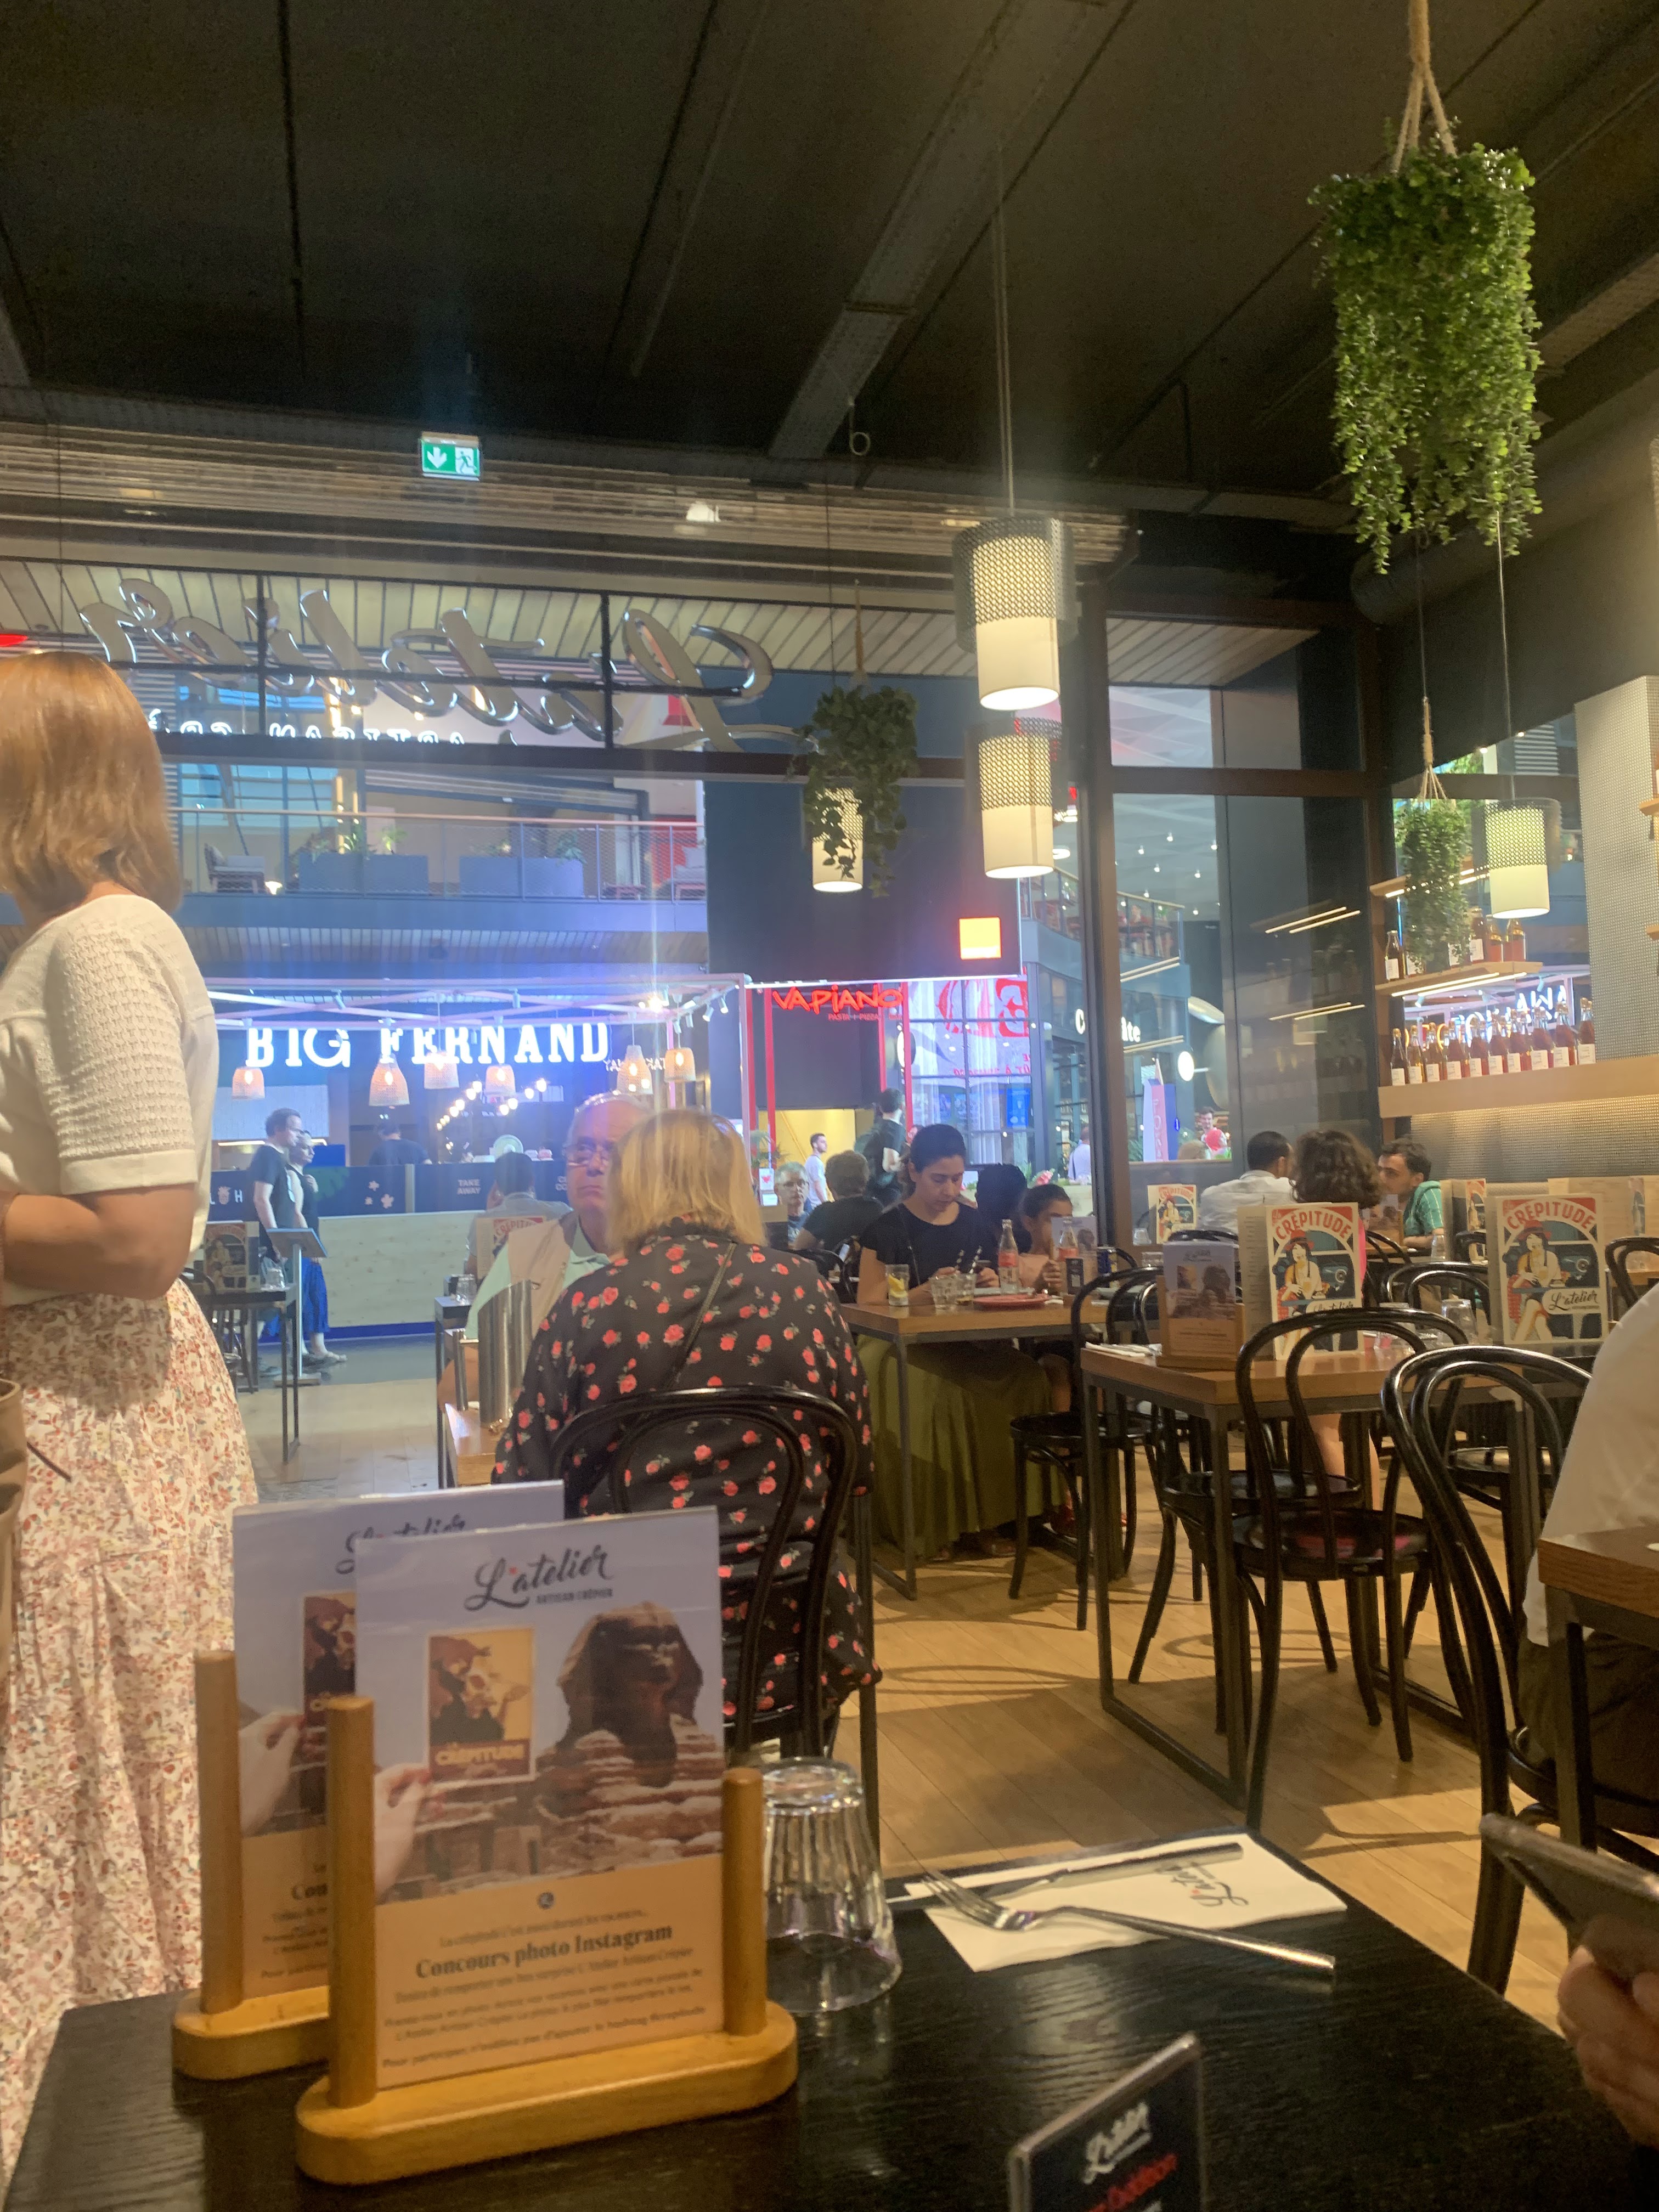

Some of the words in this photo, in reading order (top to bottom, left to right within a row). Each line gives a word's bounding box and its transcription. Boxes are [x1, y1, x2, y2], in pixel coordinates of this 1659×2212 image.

[245, 1027, 351, 1068] BIG
[379, 1022, 610, 1065] FERNAND
[456, 1187, 481, 1195] AWAY
[458, 1179, 480, 1187] TAKE
[463, 1544, 615, 1611] L'atelier
[416, 1950, 510, 1979] Concours
[515, 1942, 570, 1967] photo
[575, 1925, 673, 1952] Instagram
